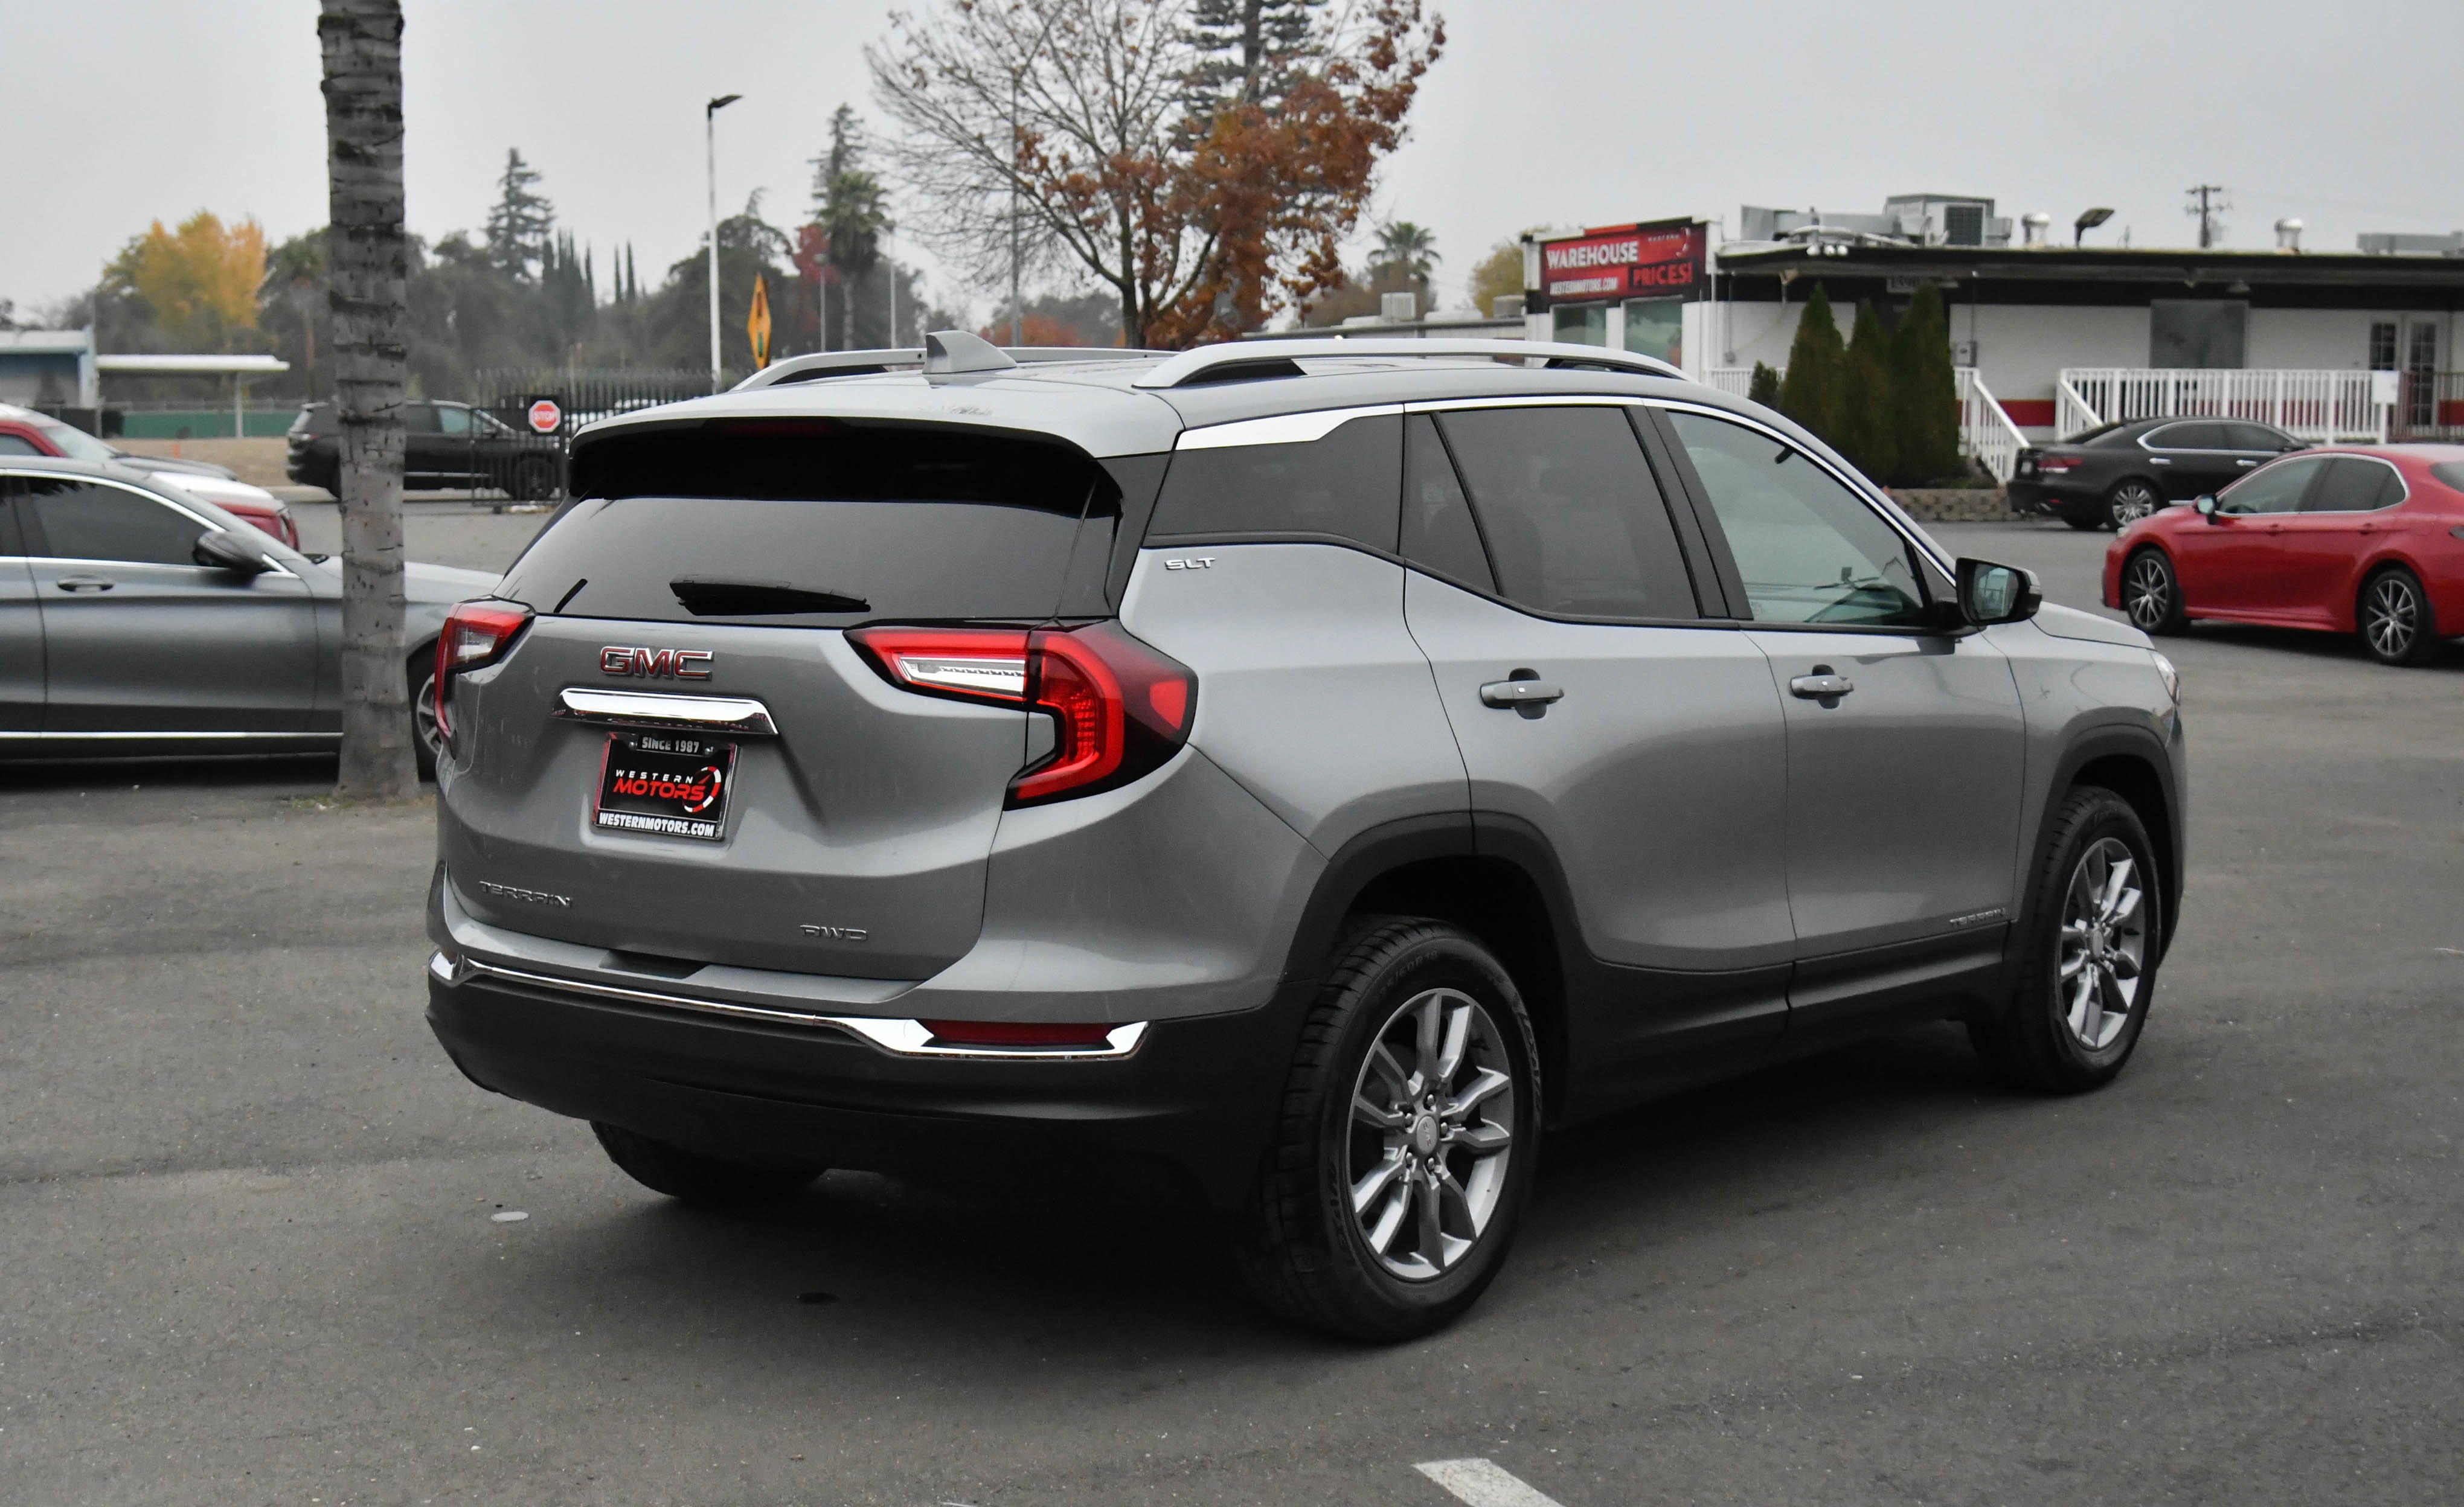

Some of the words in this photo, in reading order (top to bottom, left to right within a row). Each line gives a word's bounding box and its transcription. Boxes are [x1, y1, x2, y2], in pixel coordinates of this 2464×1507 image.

[1546, 240, 1638, 270] WAREHOUSE
[1633, 261, 1693, 286] PRICES!
[533, 411, 557, 422] STOP
[1164, 557, 1216, 571] SLT
[600, 645, 715, 681] GMC
[641, 736, 672, 751] SINCE
[675, 740, 700, 754] 1987
[615, 769, 693, 784] WESTERN
[613, 777, 706, 801] MOTORS
[598, 811, 714, 837] WESTERNMOTORS.COM
[479, 880, 573, 908] TERRAIN
